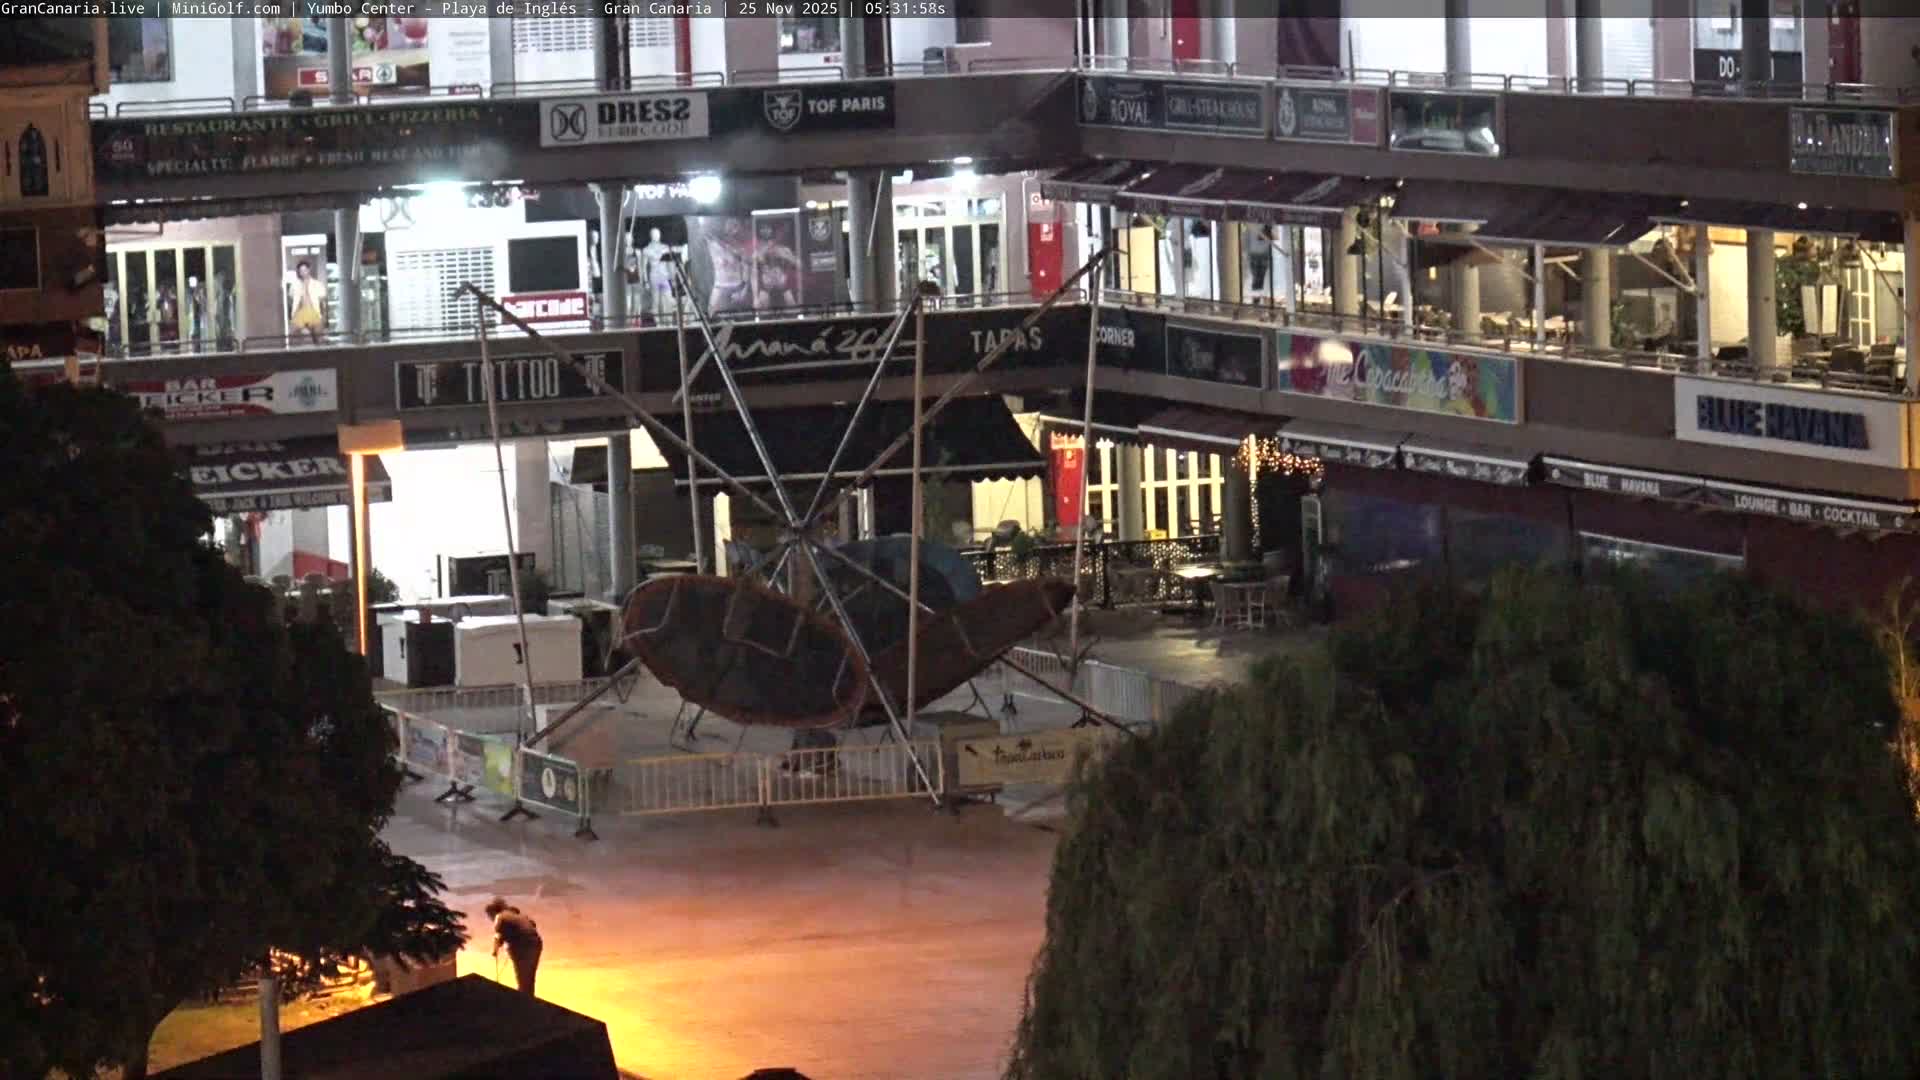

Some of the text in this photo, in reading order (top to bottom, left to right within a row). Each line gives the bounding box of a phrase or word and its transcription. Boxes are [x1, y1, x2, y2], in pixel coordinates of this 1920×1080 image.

[315, 68, 371, 84] SR
[807, 95, 885, 114] TOF PARIS
[970, 326, 1043, 354] TAPAS
[165, 377, 216, 391] BAR
[461, 357, 559, 402] TATTOO
[1696, 394, 1871, 451] BLUE HAVANA
[1583, 472, 1661, 497] BLUE HAVANA
[1734, 494, 1880, 527] LOUNGE BAR COCKTAIL
